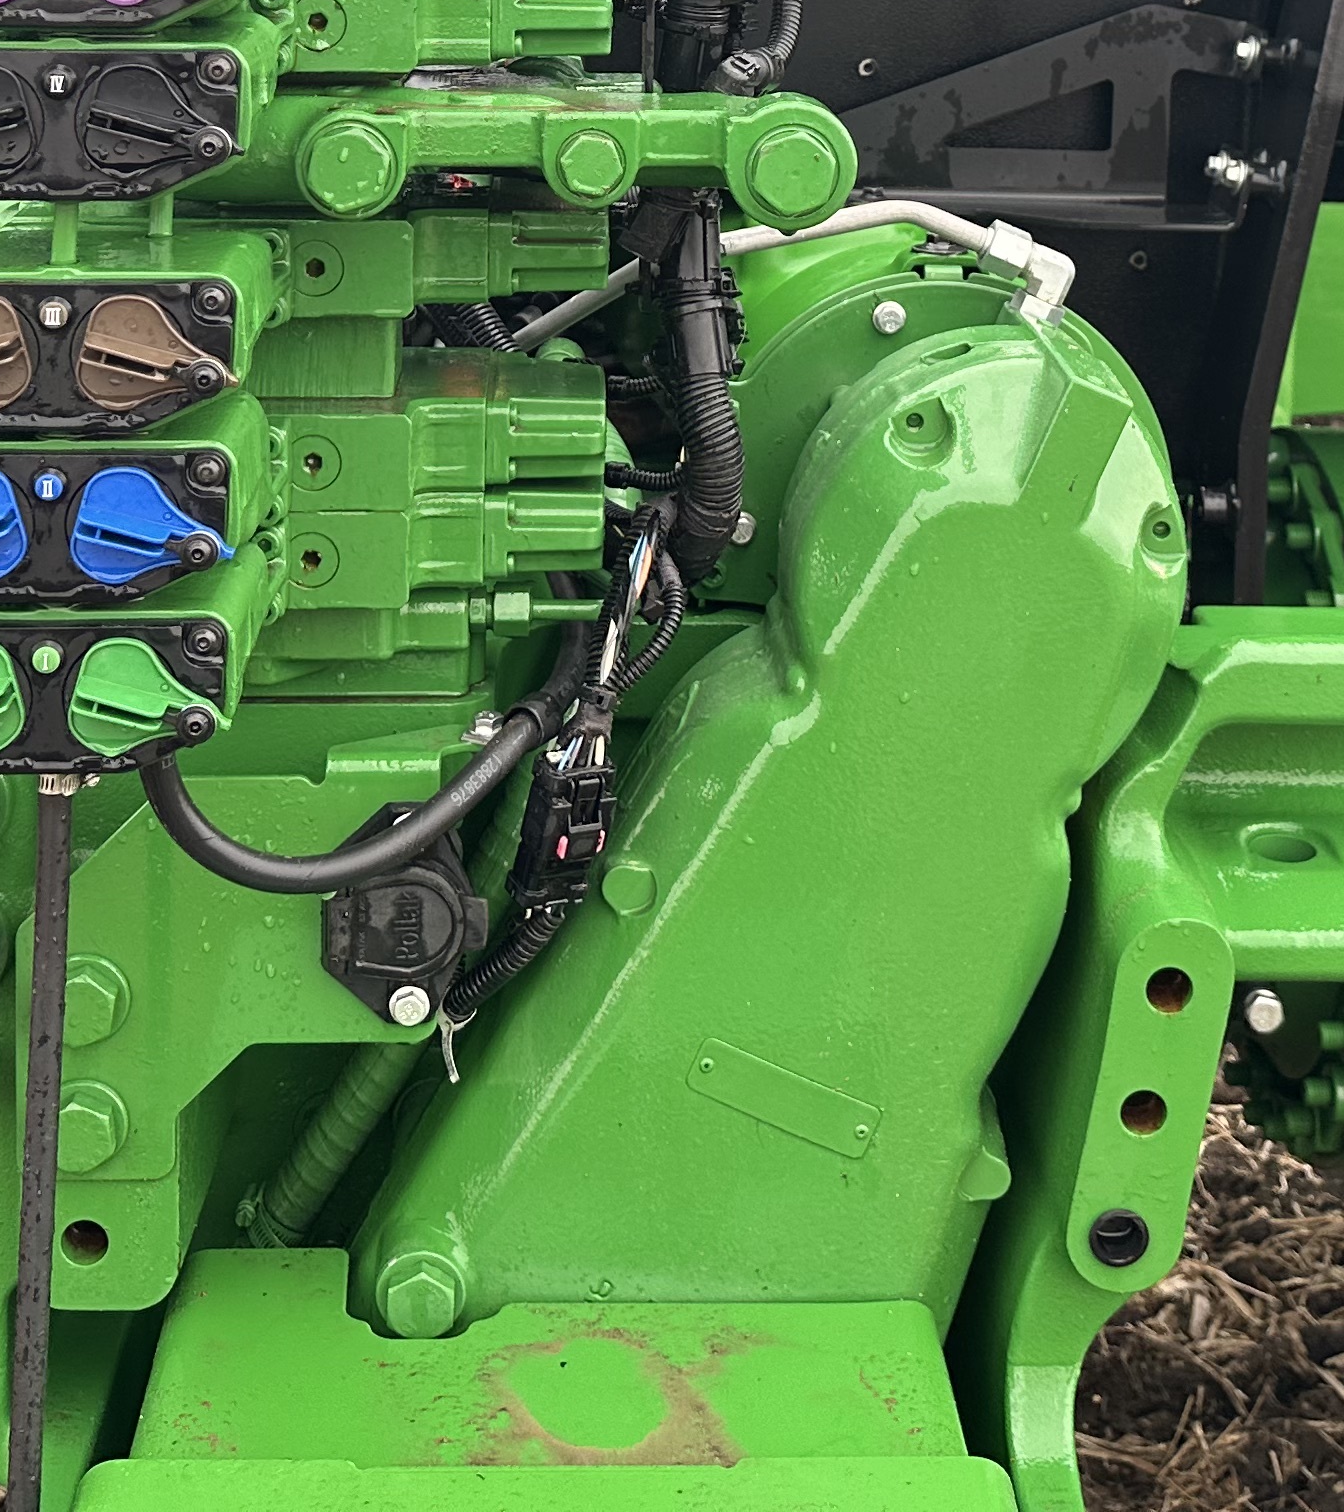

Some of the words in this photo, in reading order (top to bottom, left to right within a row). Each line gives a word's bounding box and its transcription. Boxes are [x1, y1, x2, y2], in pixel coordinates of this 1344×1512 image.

[49, 75, 65, 93] IV
[44, 307, 62, 326] III
[41, 478, 54, 498] II
[41, 652, 49, 671] I
[450, 753, 502, 807] 12883876
[393, 890, 420, 960] Pollak
